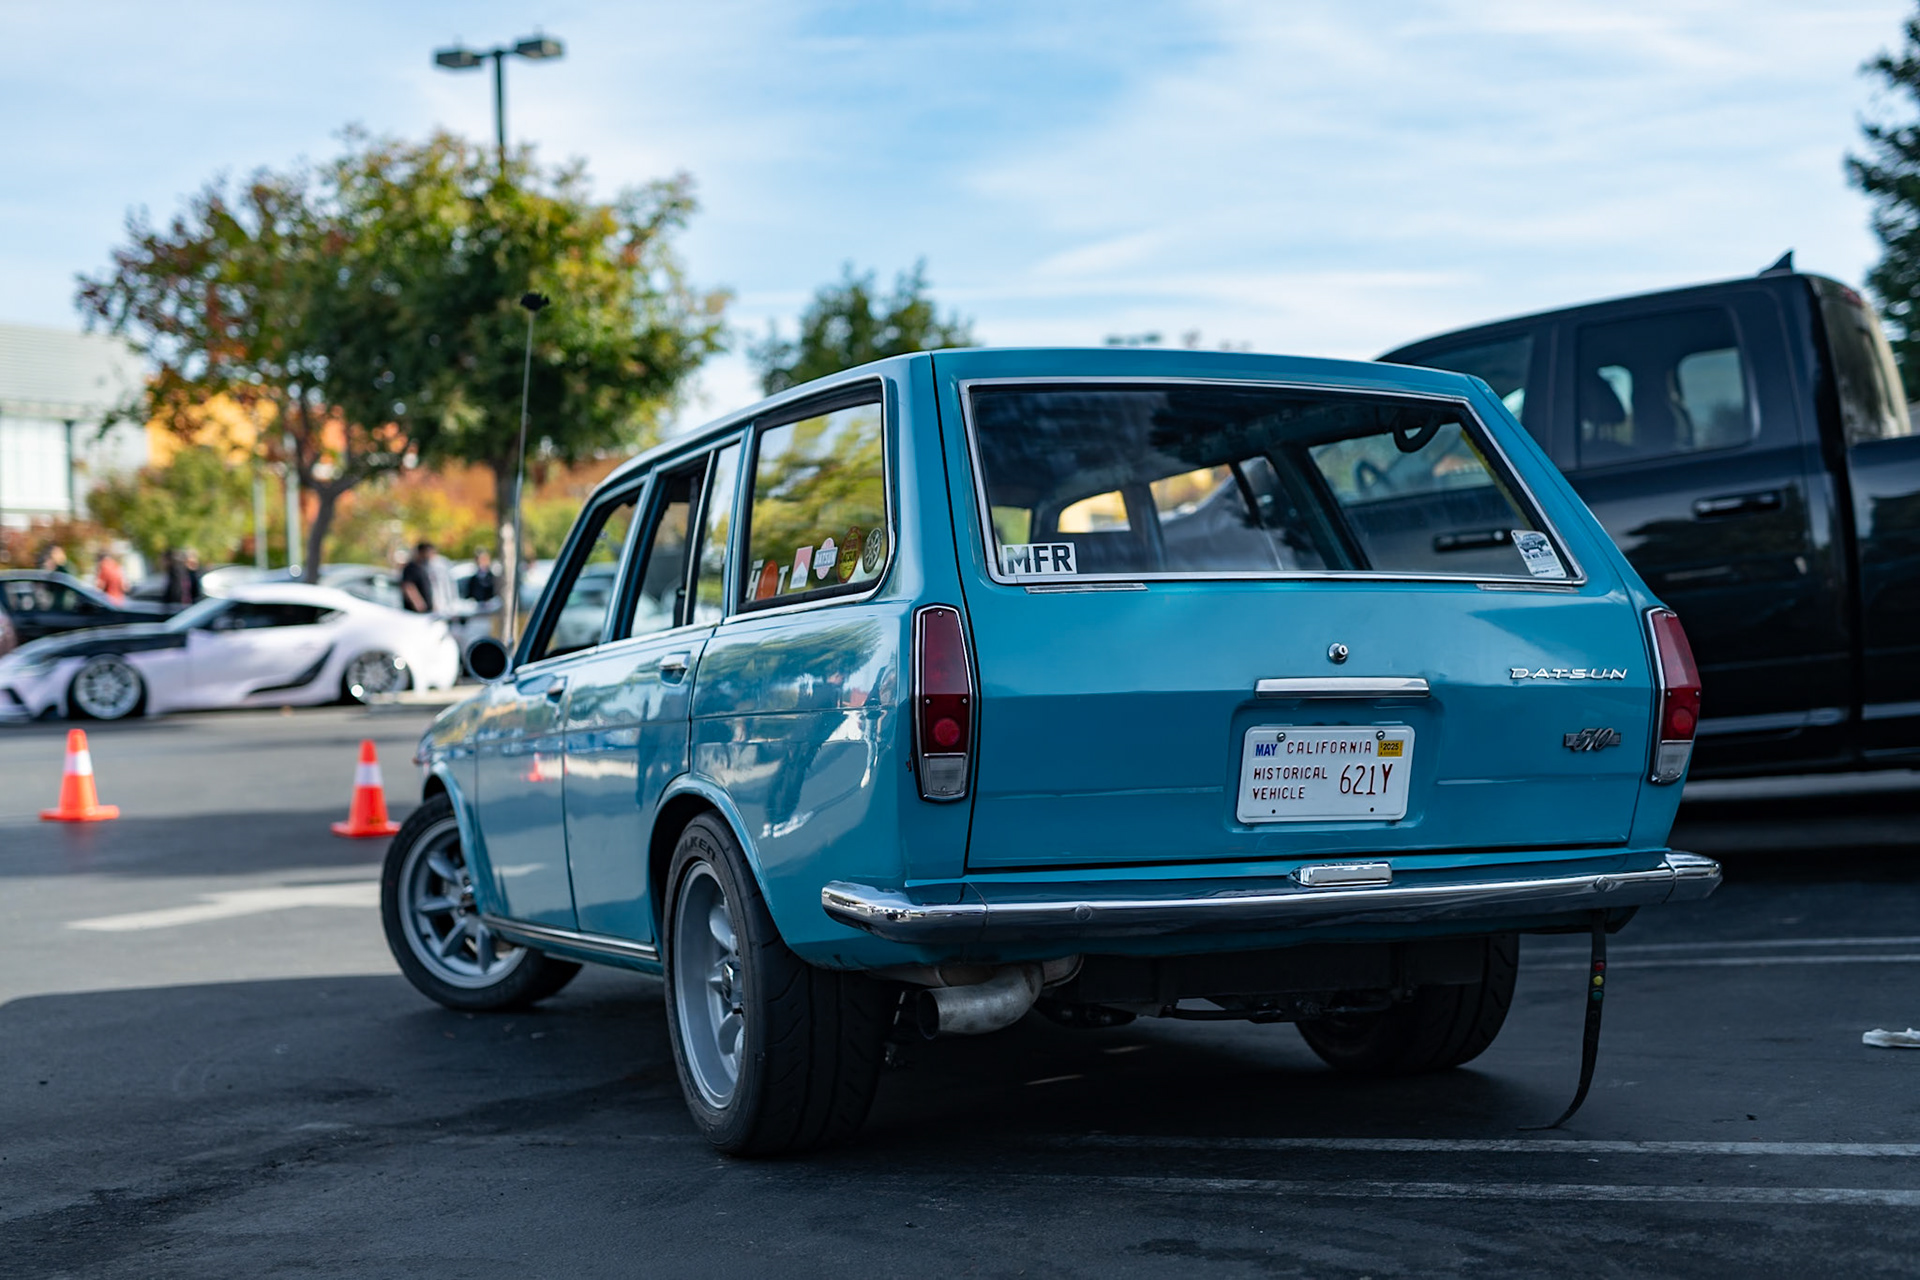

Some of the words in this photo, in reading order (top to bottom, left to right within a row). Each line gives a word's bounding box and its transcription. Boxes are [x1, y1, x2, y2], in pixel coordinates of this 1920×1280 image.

[1006, 545, 1073, 574] MFR
[1510, 668, 1627, 679] DATSUN
[1383, 742, 1399, 750] 2025
[1573, 728, 1614, 751] 510
[1255, 743, 1278, 756] MAY
[1287, 741, 1372, 754] CALIFORNIA
[1254, 766, 1328, 780] HISTORICAL
[1340, 763, 1393, 796] 621Y
[1253, 786, 1305, 799] VEHICLE
